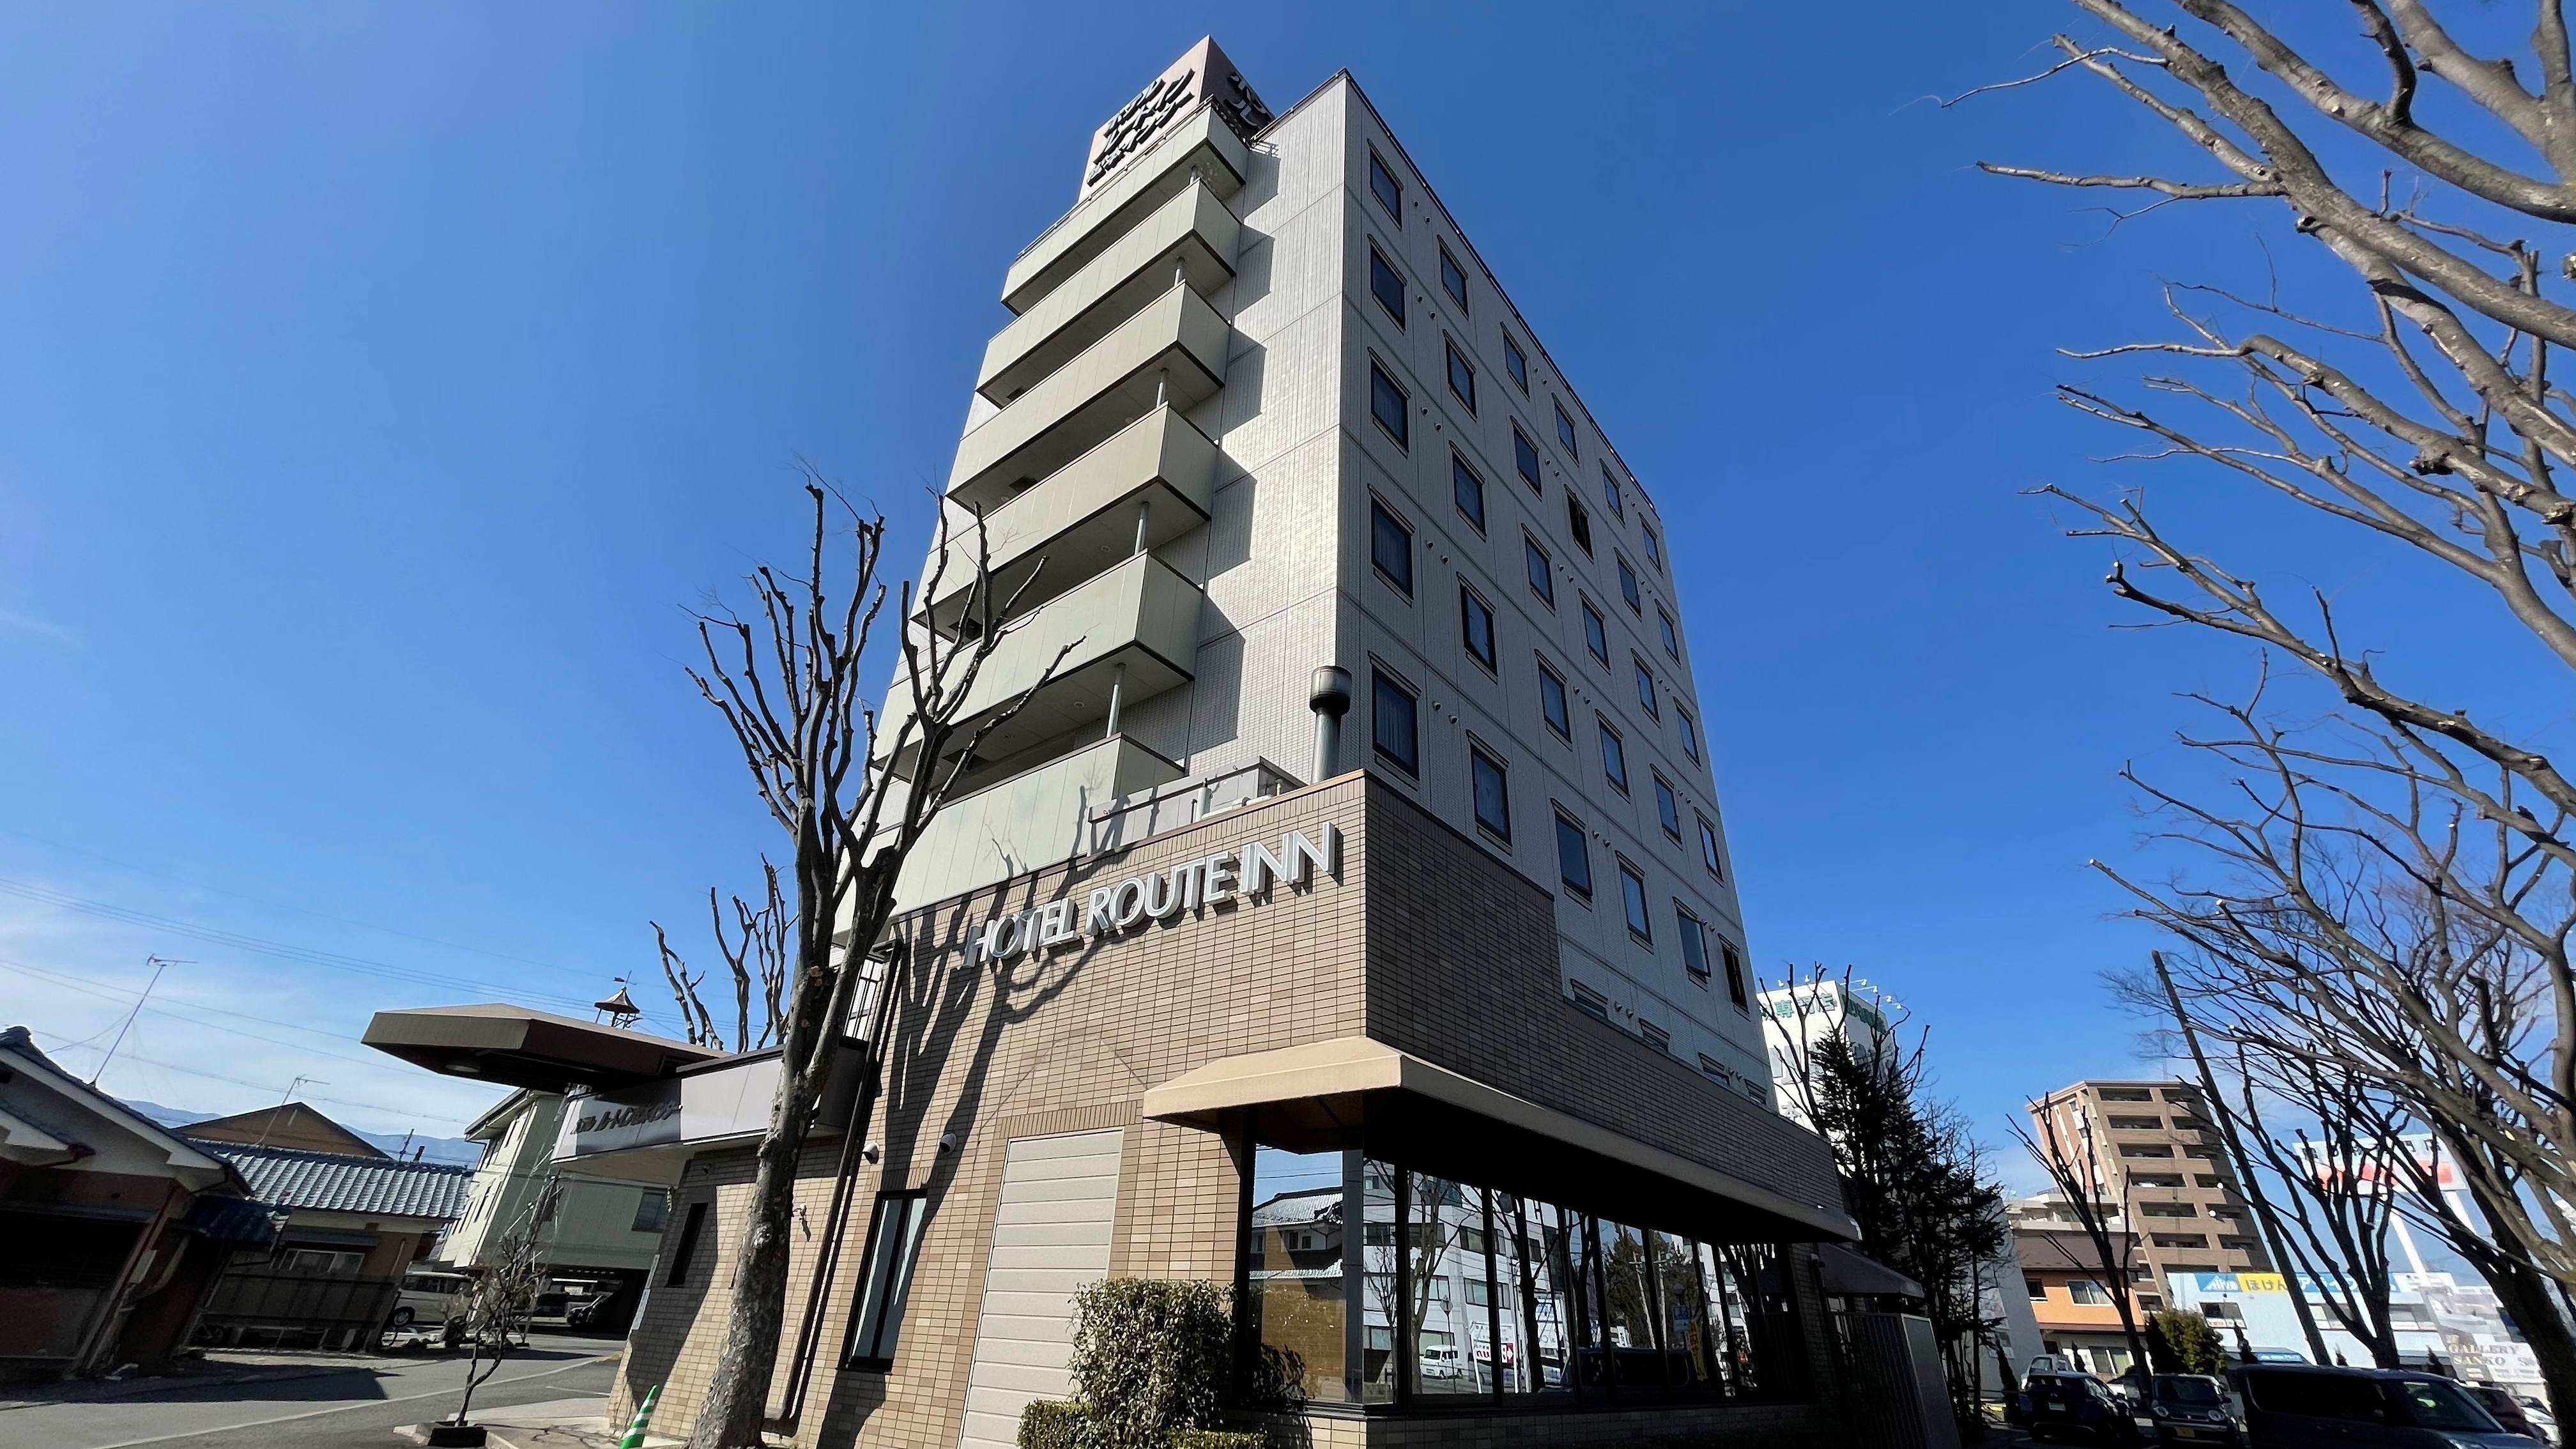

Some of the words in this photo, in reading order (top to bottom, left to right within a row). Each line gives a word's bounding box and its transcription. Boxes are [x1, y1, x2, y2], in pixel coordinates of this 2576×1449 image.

[963, 897, 1080, 969] HOTEL
[1085, 850, 1234, 937] ROUTE
[1239, 821, 1337, 896] INN
